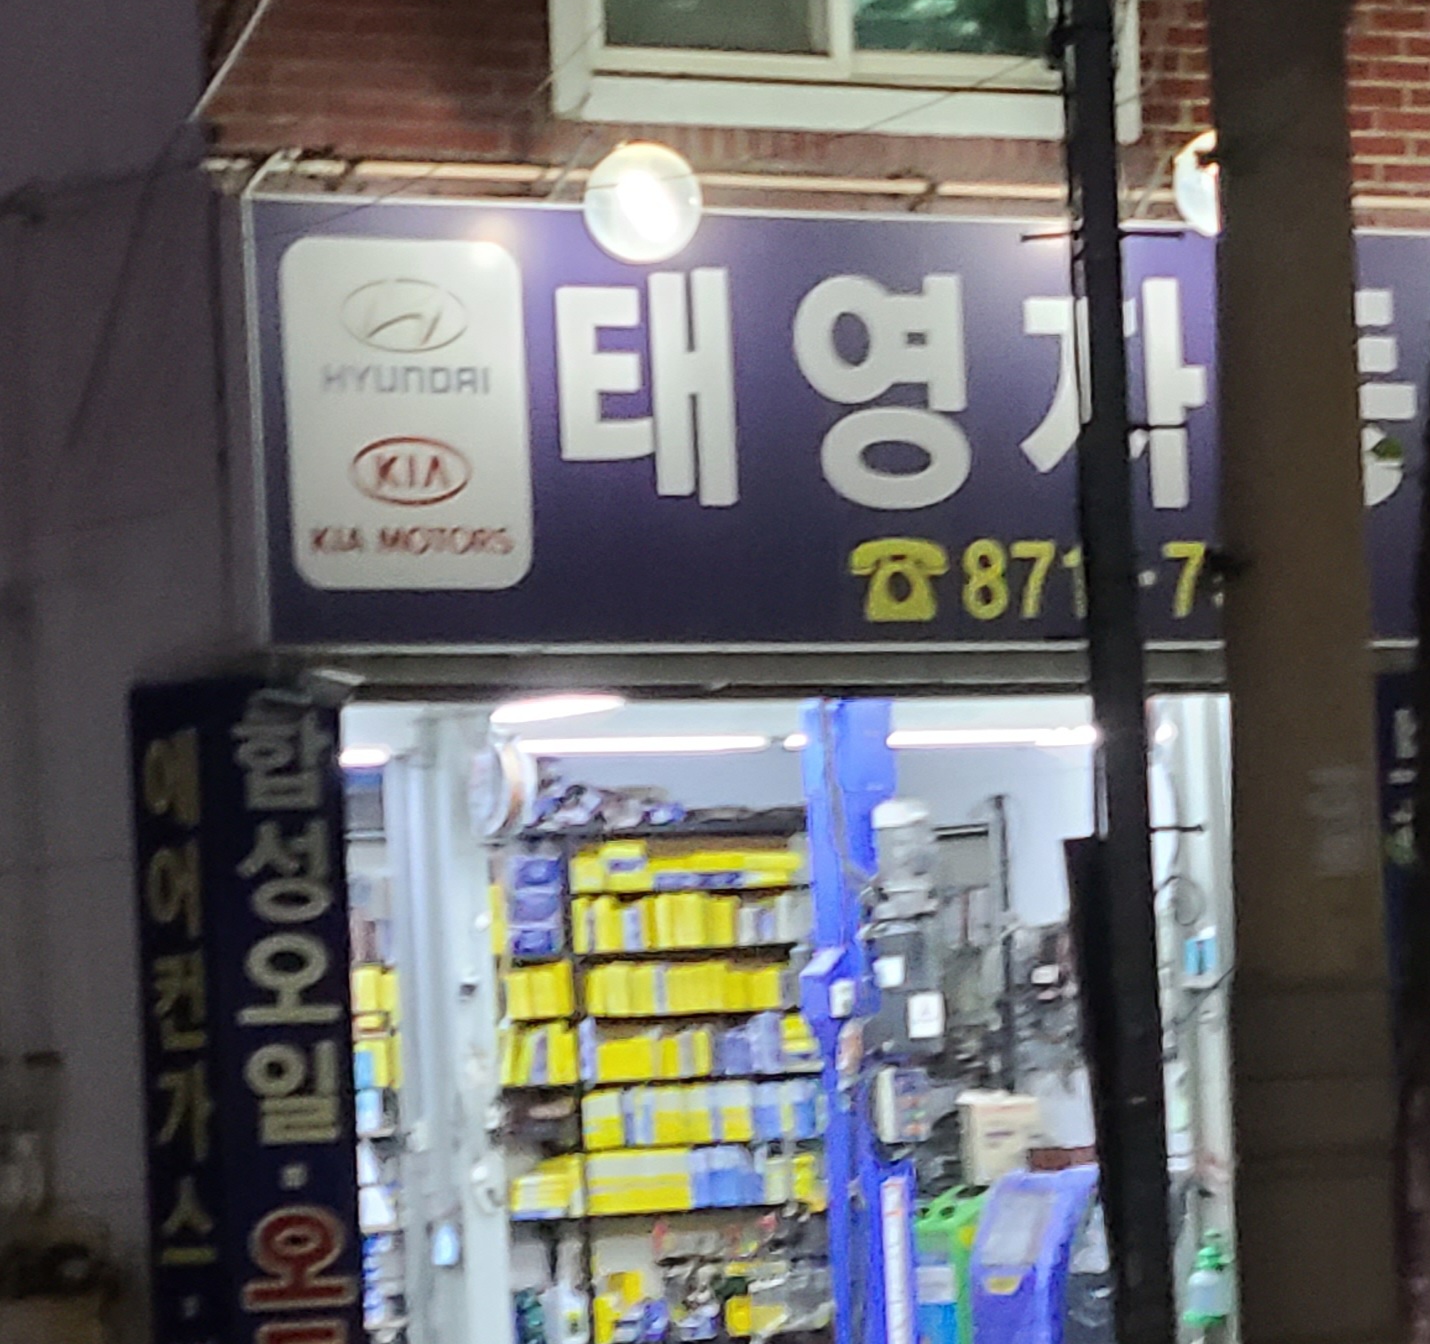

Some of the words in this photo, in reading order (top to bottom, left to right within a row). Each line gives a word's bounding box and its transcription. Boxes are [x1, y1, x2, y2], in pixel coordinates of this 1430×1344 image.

[321, 364, 491, 396] HYUNDAI
[373, 454, 449, 489] KIA
[310, 526, 364, 554] KIA
[378, 526, 515, 556] MOTORS
